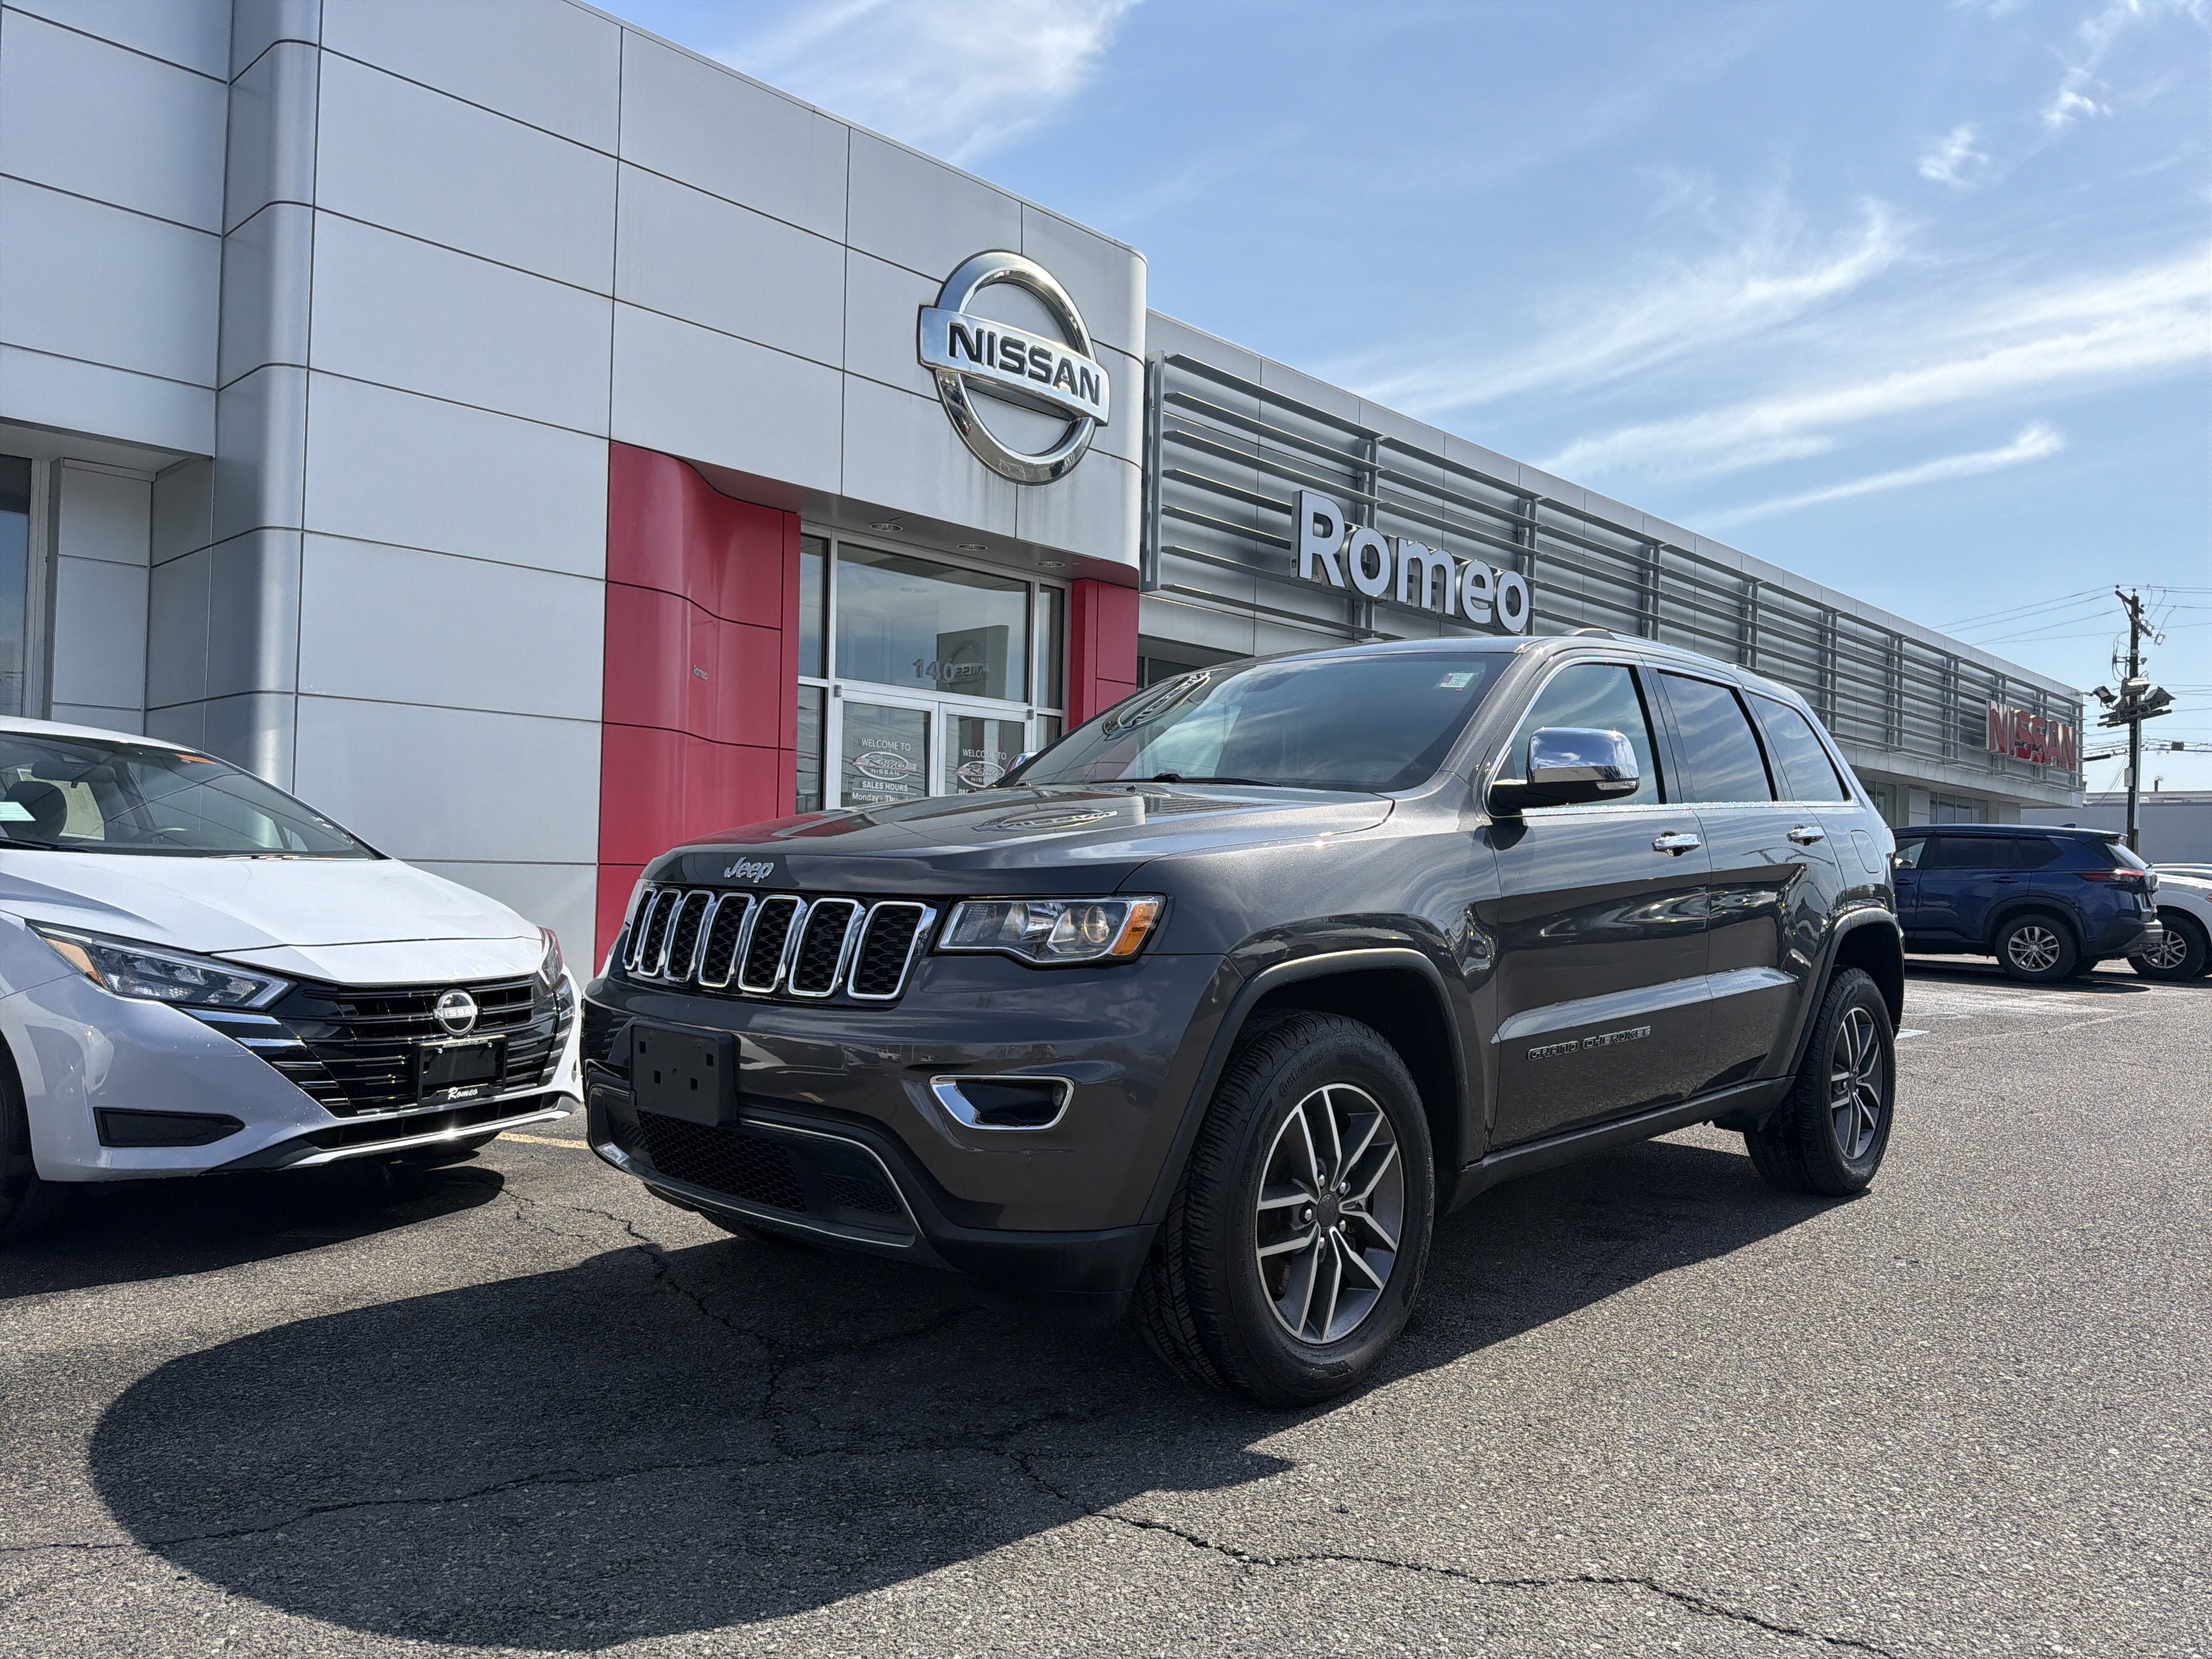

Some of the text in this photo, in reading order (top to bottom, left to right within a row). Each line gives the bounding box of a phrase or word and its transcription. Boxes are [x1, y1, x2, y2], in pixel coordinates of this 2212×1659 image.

[948, 321, 1100, 408] NISSAN
[1293, 490, 1530, 632] Romeo
[912, 658, 955, 681] 140
[1987, 699, 2076, 772] NISSAN
[861, 738, 911, 751] WELCOME TO
[867, 753, 907, 769] Romeo
[962, 749, 996, 758] WELCOME
[862, 781, 883, 789] SALES
[852, 792, 879, 803] Monday
[724, 856, 774, 883] Jeep
[435, 1006, 478, 1018] NISSAN
[1527, 1025, 1651, 1061] GRAND CHEROKEE
[448, 1087, 478, 1100] Romeo
